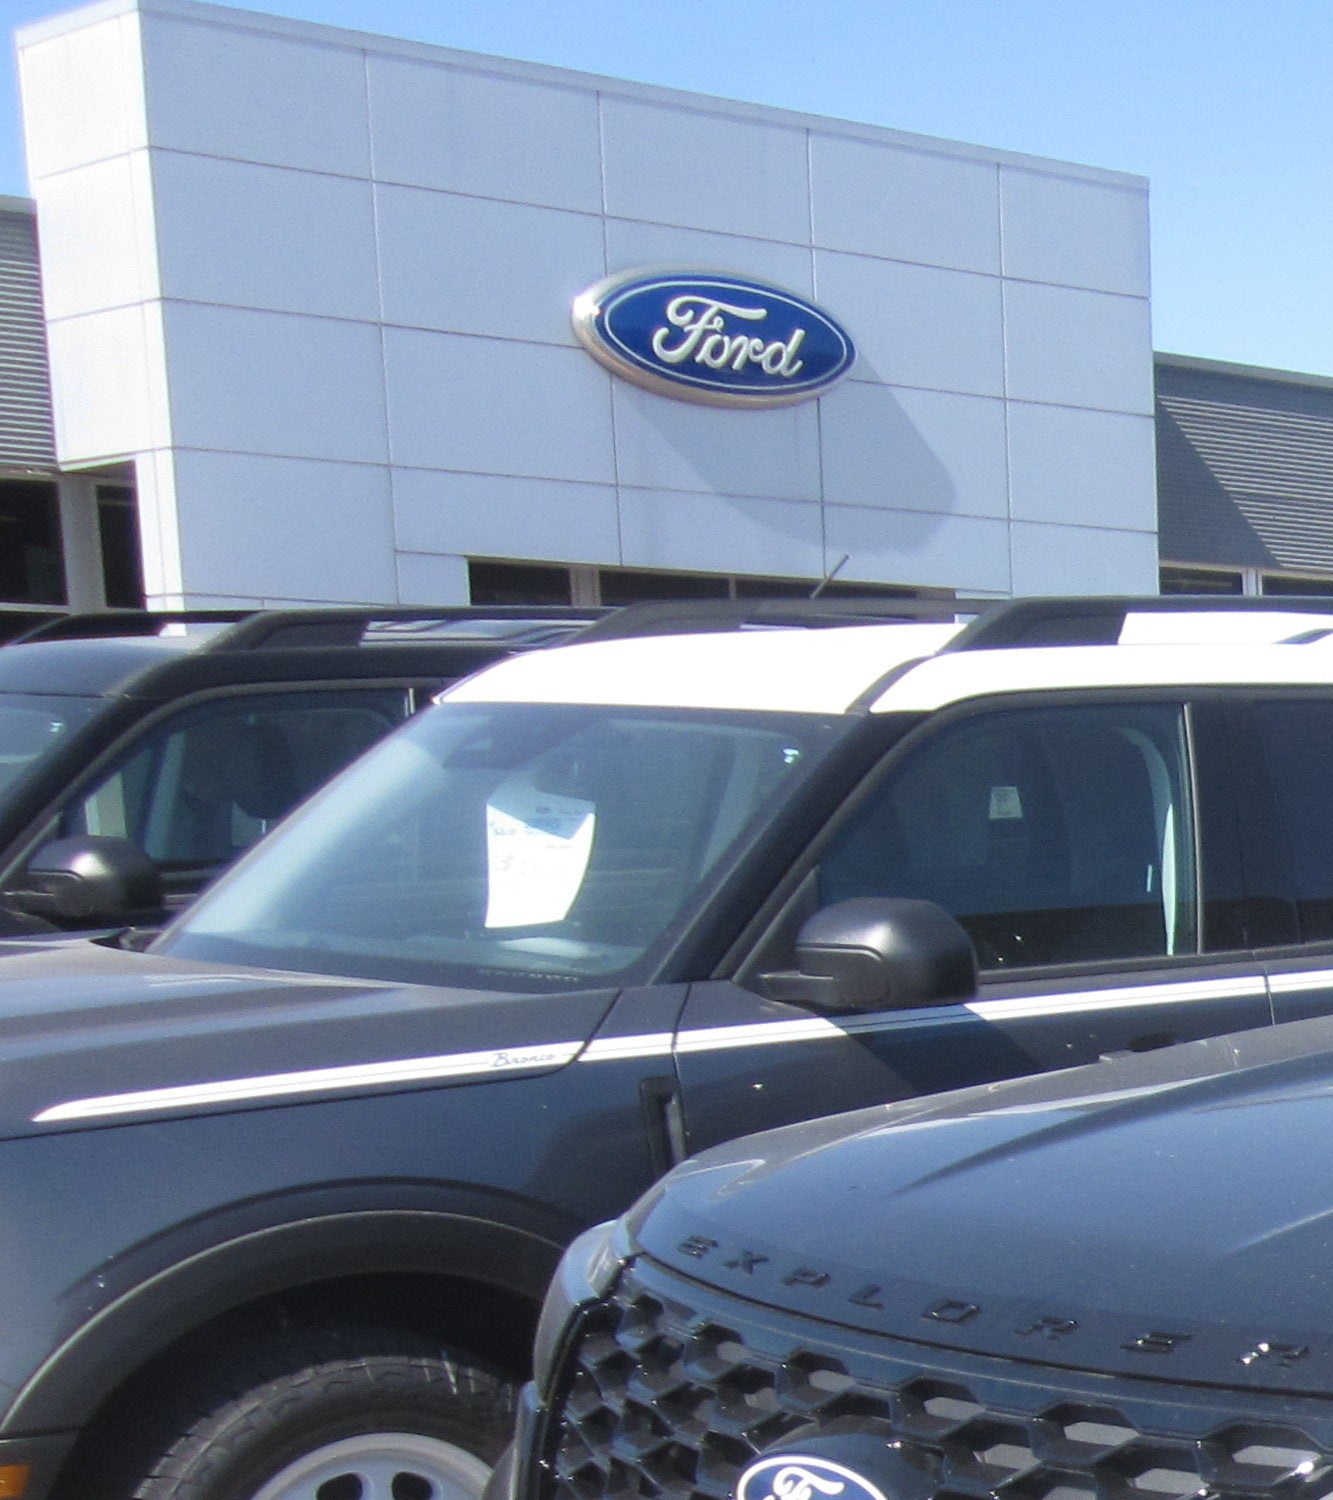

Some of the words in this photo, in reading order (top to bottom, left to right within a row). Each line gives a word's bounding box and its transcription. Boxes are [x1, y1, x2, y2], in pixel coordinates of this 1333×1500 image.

[652, 295, 806, 378] Ford
[490, 1052, 556, 1067] Bronco
[677, 1234, 1311, 1368] EXPLORER
